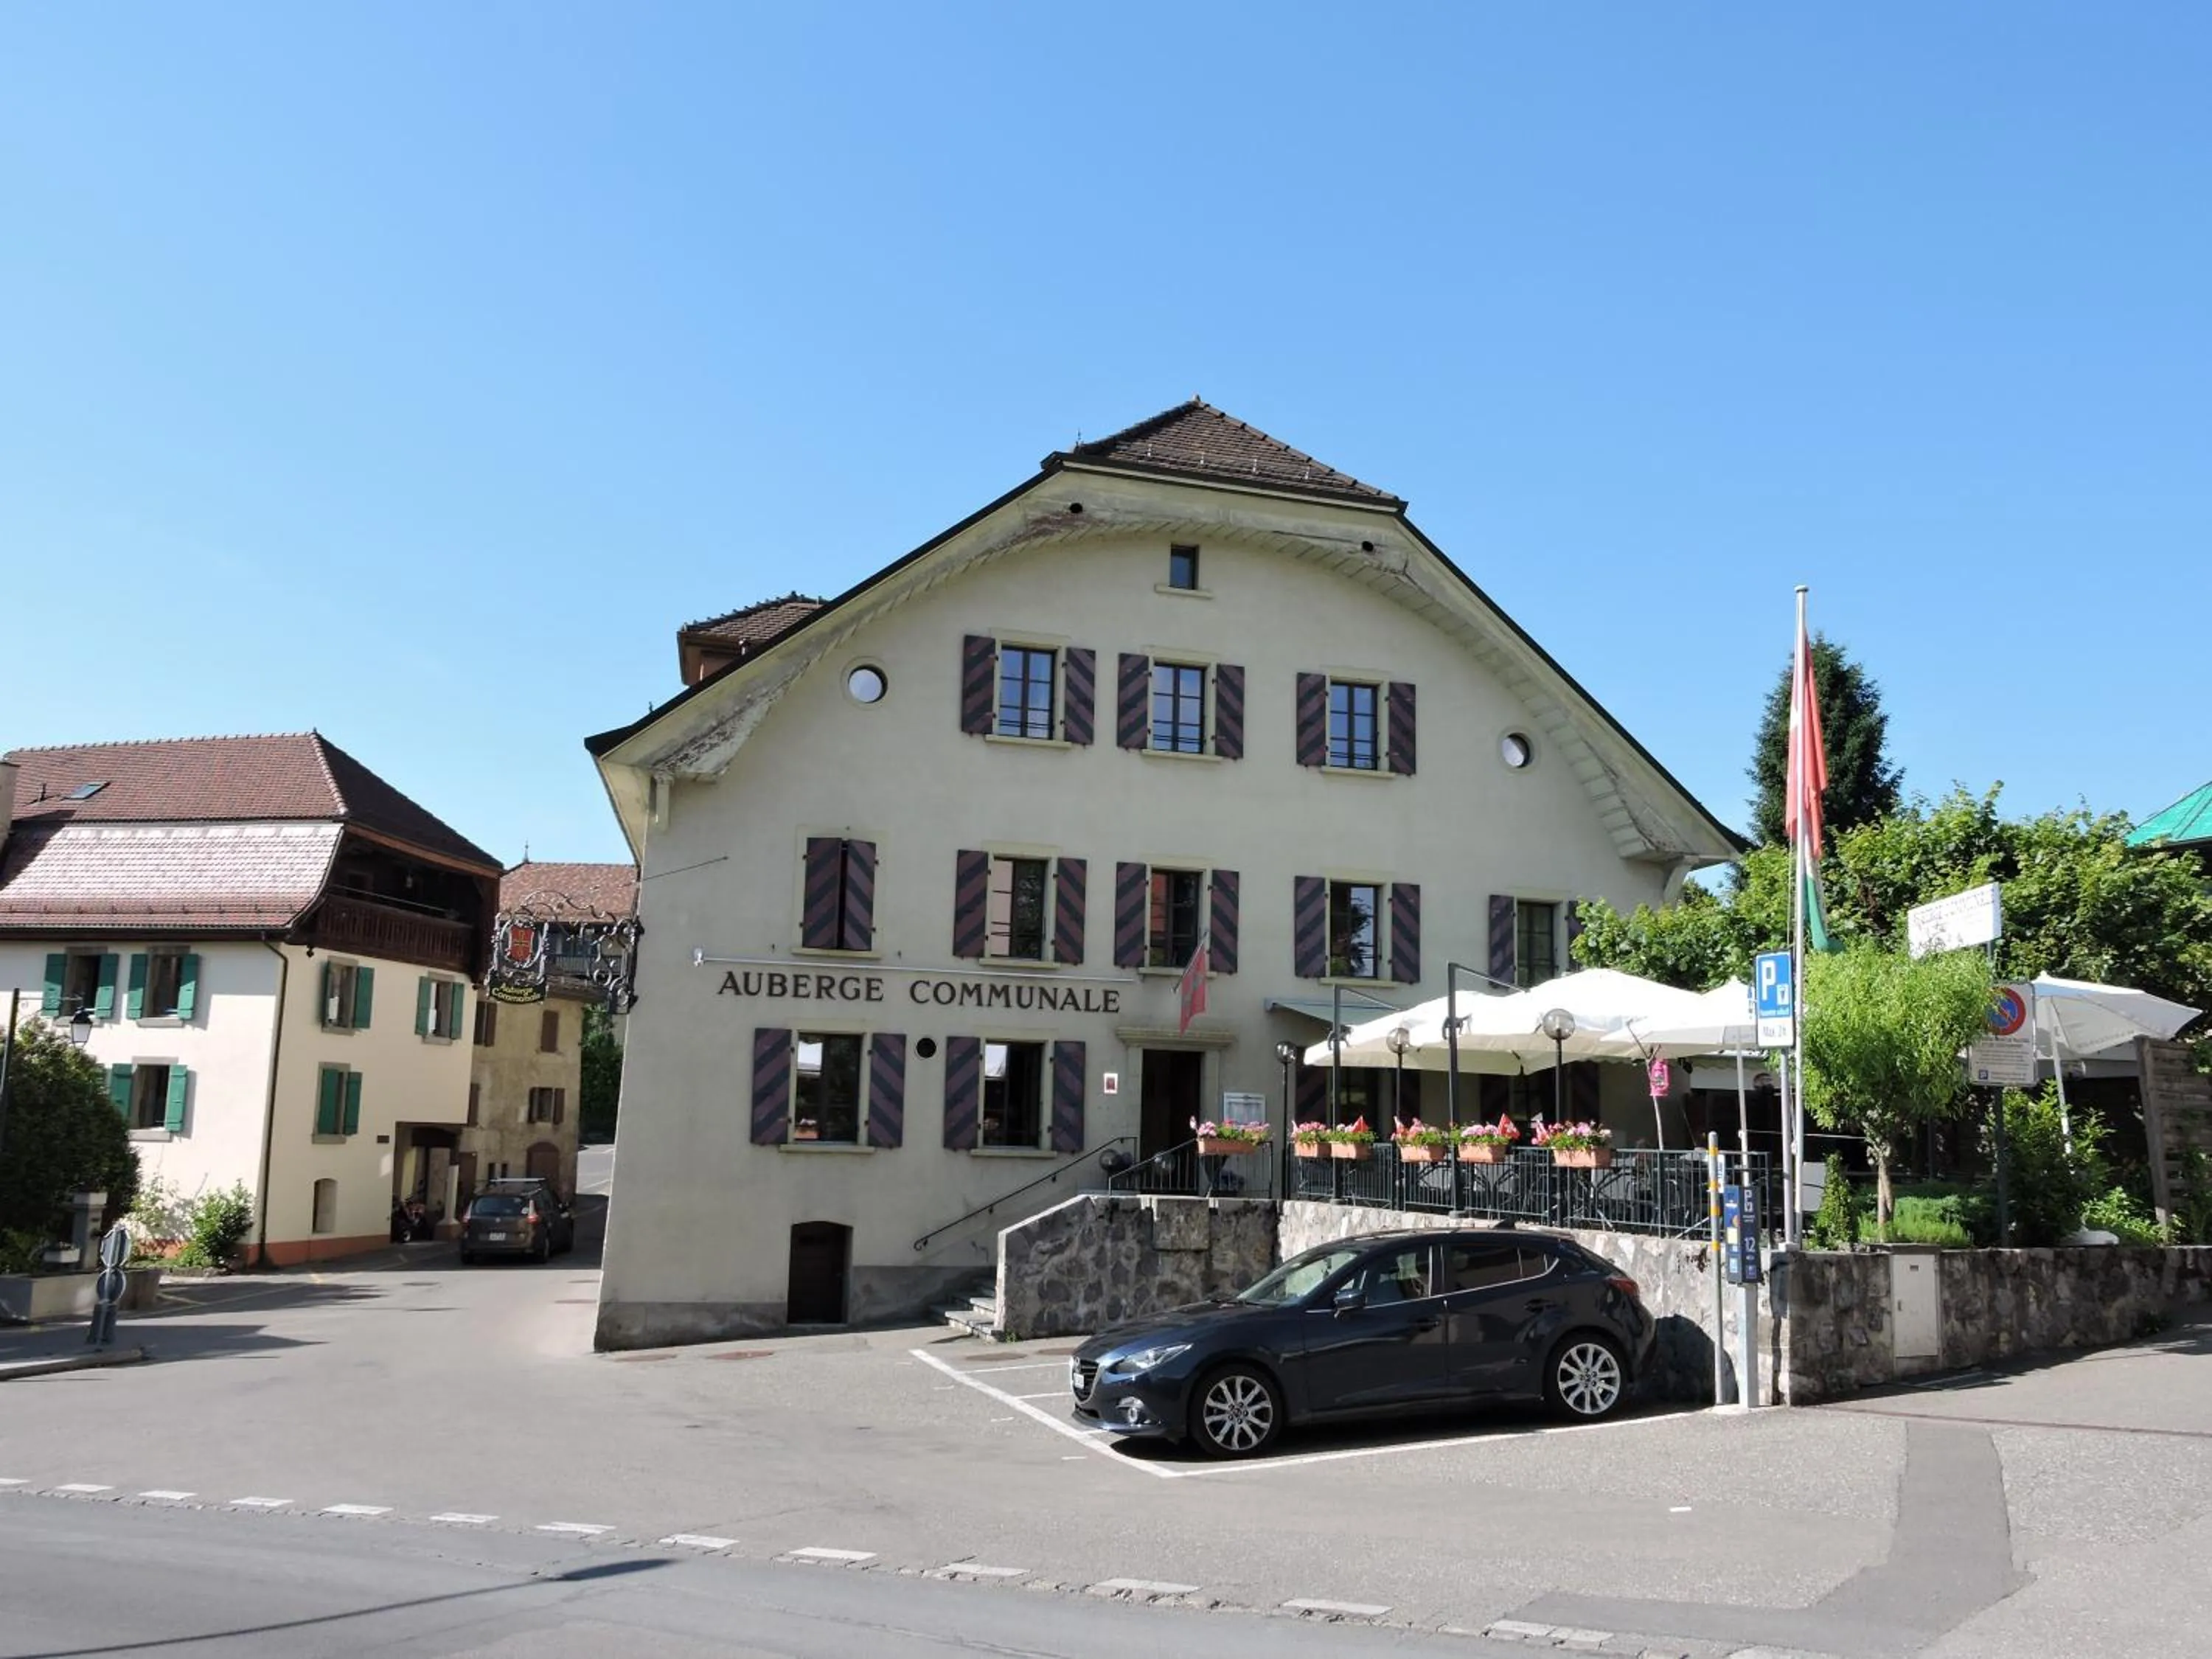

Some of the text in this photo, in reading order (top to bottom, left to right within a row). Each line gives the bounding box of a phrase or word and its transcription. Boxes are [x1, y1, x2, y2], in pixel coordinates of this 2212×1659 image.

[717, 970, 1120, 1014] AUBERGE COMMUNALE
[1761, 960, 1776, 1001] P
[1744, 1189, 1753, 1201] P
[1744, 1236, 1756, 1253] 12
